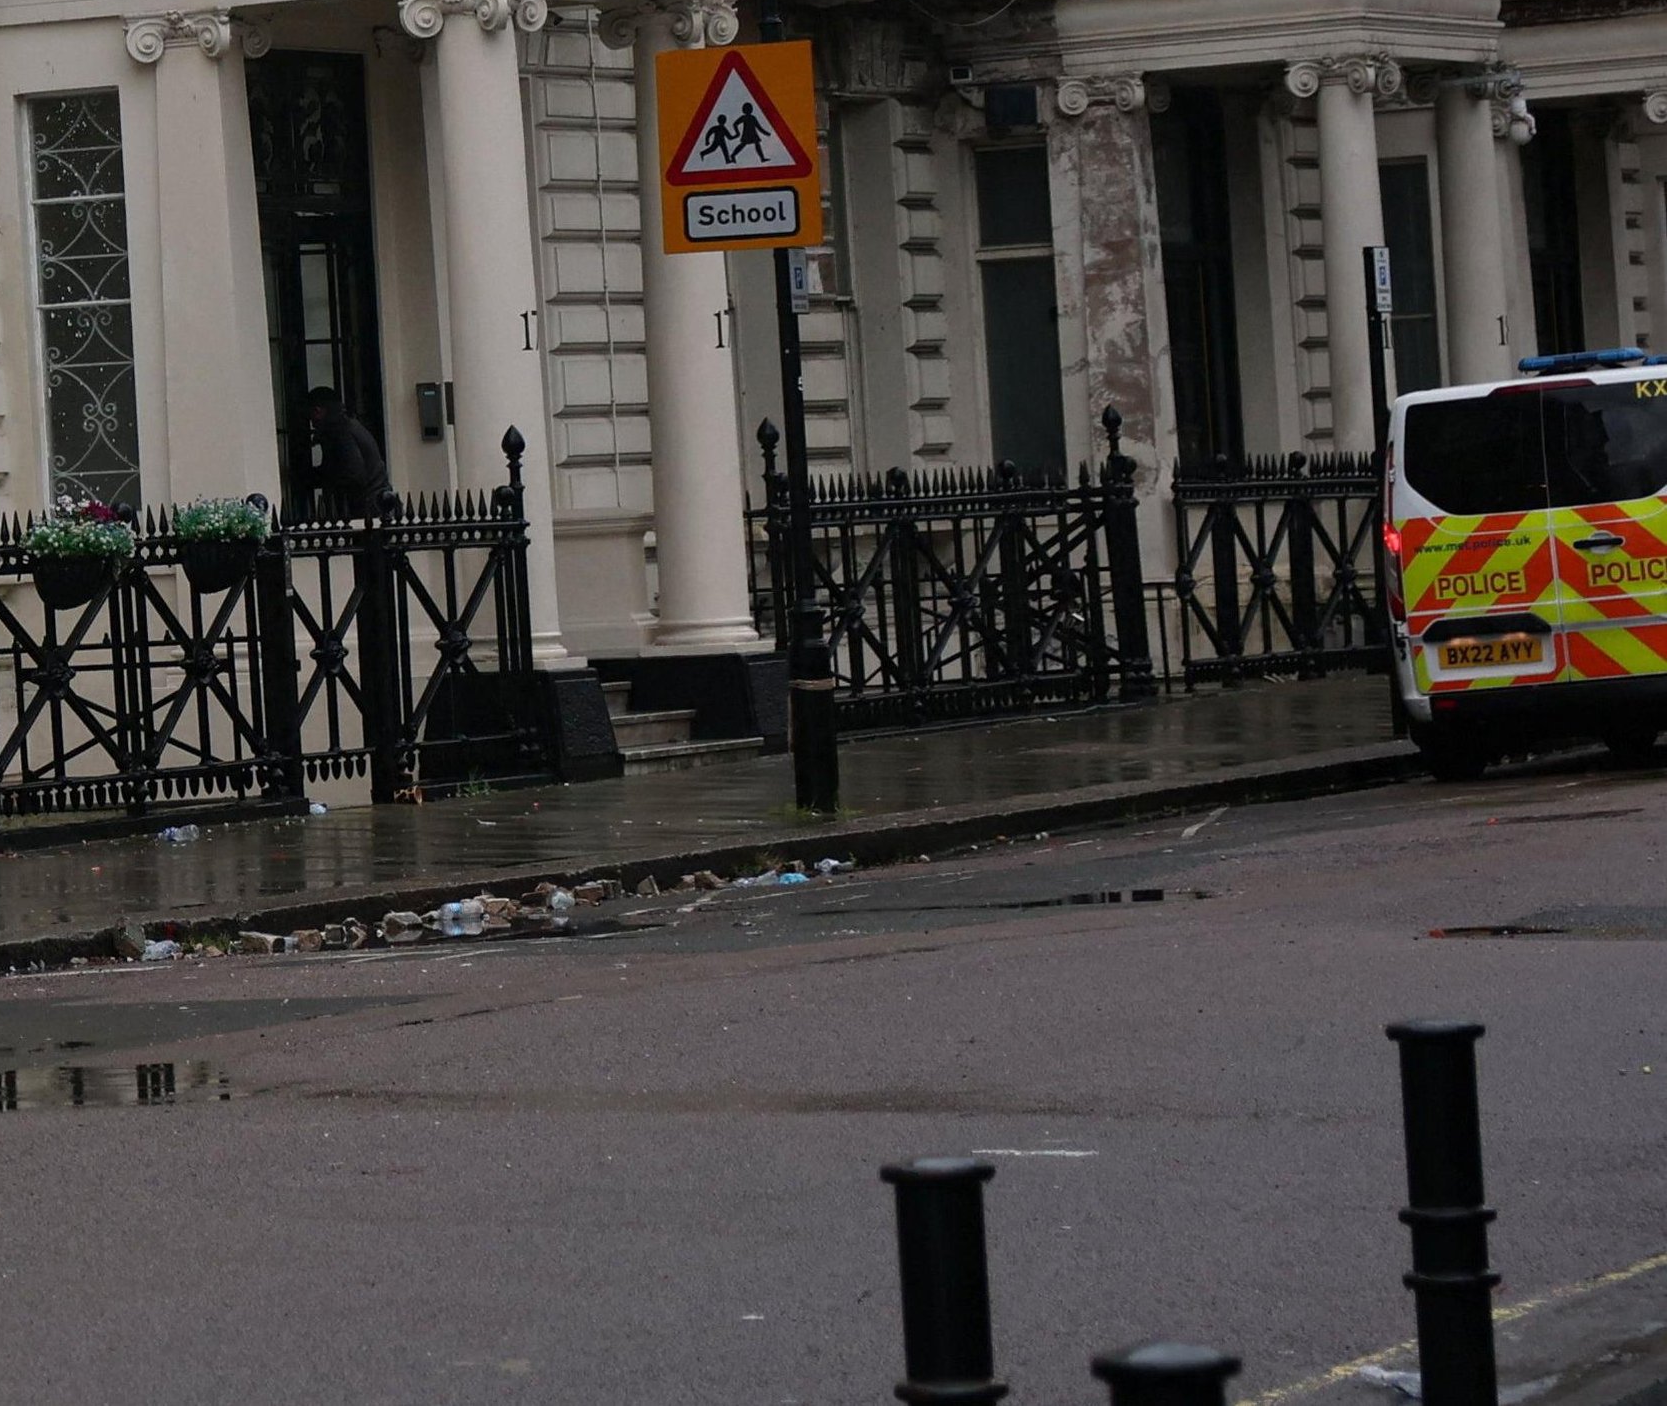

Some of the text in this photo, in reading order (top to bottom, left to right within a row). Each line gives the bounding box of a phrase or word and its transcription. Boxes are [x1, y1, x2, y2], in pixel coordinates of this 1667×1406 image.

[698, 201, 786, 225] School
[1415, 535, 1531, 555] www.met.police.uk
[1590, 557, 1667, 585] POLIC
[1438, 571, 1522, 597] POLICE
[1447, 643, 1534, 665] BX22 AYY
